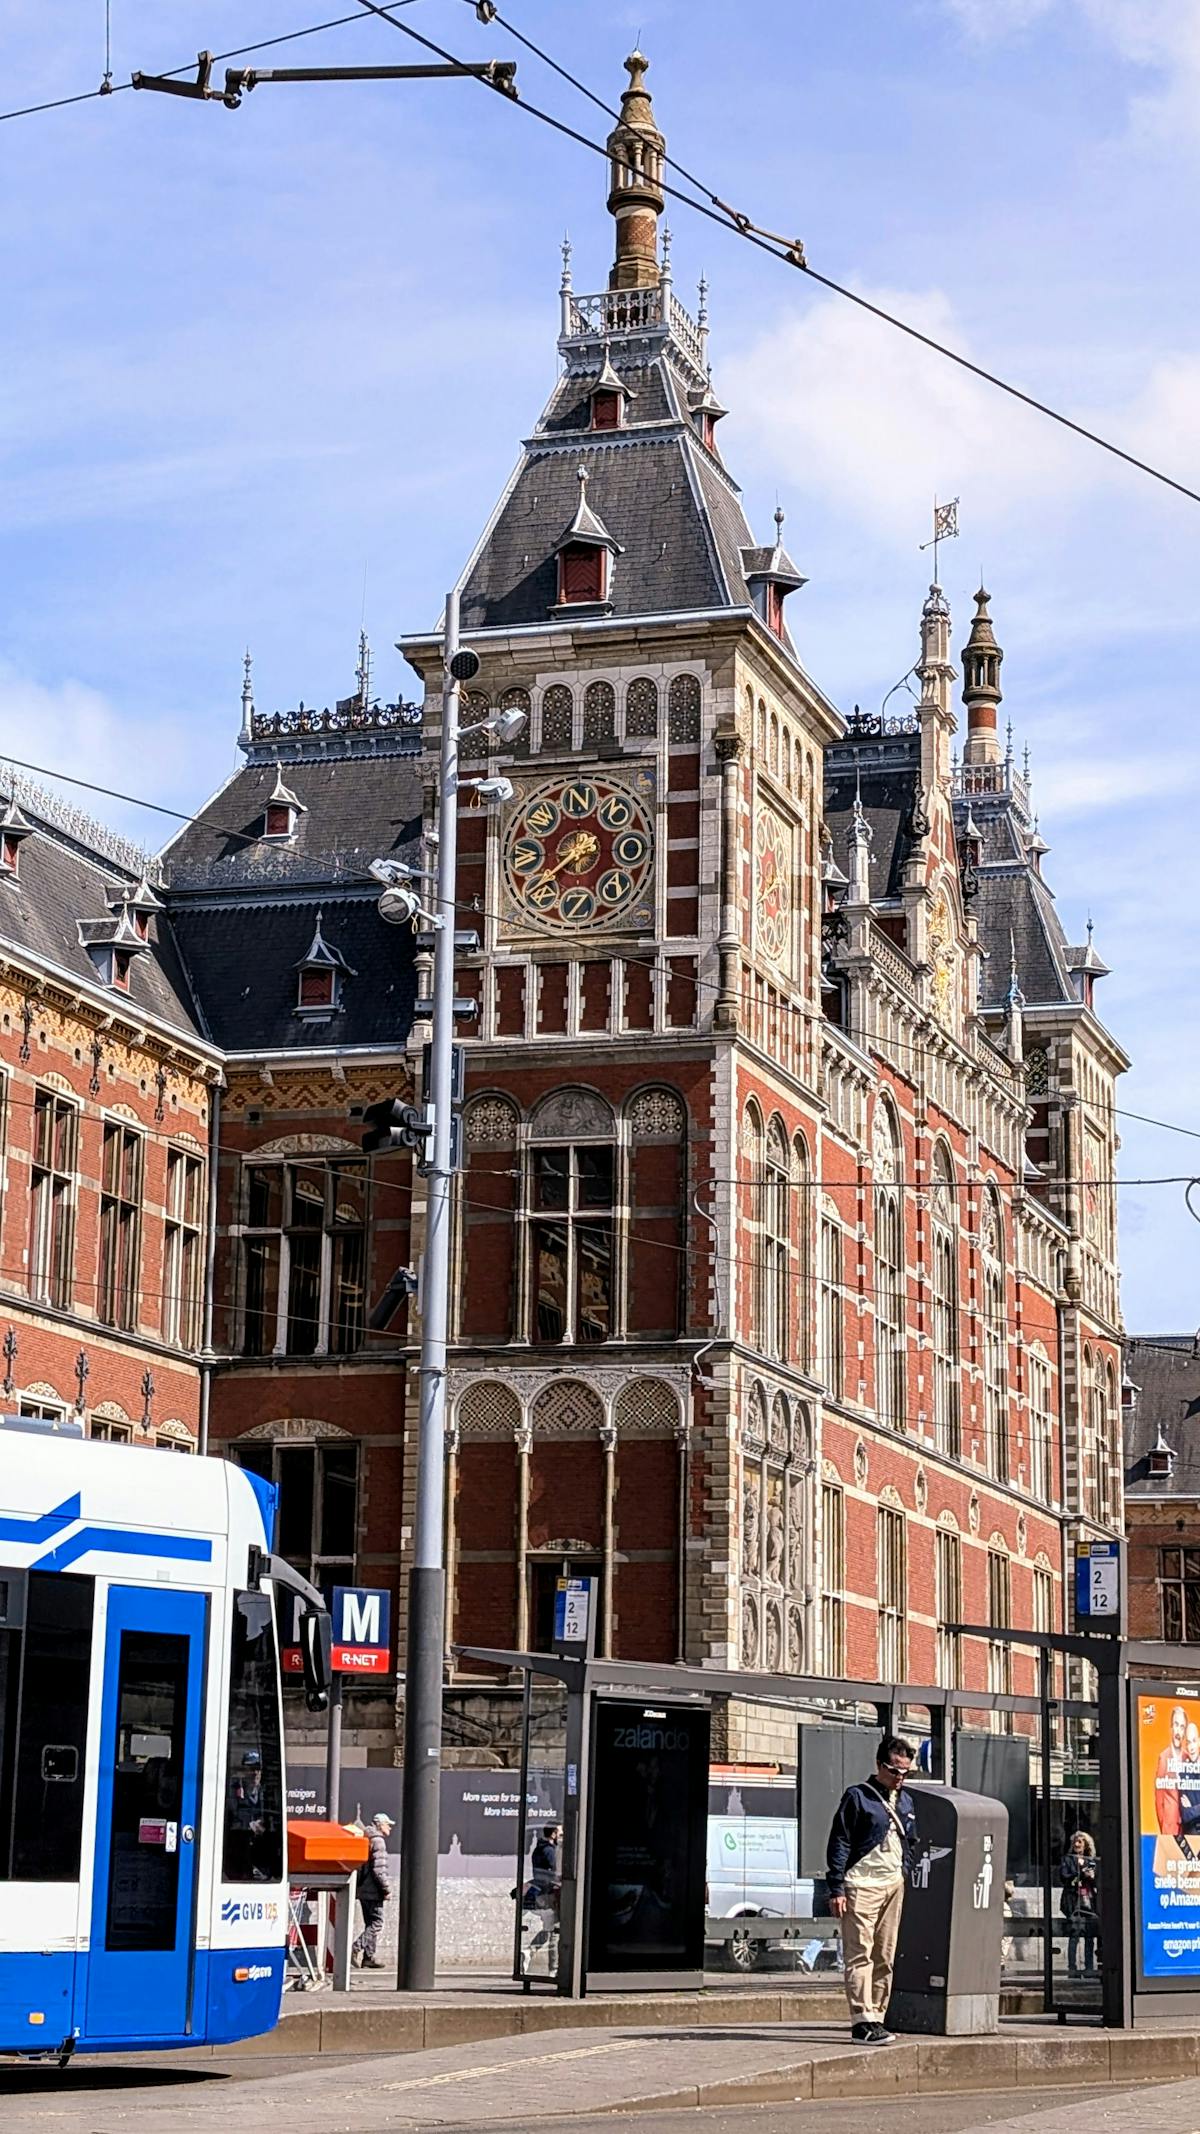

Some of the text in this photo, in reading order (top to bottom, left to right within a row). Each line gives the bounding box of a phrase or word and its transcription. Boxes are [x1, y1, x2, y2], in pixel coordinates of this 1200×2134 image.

[568, 788, 591, 812] N
[514, 844, 537, 870] W
[619, 837, 643, 862] O
[566, 893, 589, 919] Z
[1094, 1570, 1102, 1584] 2
[568, 1601, 575, 1614] 2
[1092, 1593, 1108, 1608] 12
[342, 1593, 380, 1644] M
[566, 1621, 578, 1634] 12
[341, 1652, 378, 1667] R-NET
[613, 1724, 690, 1751] zalando
[462, 1792, 480, 1802] More
[481, 1793, 499, 1803] space
[483, 1807, 500, 1816] More
[242, 1902, 263, 1920] GVB
[1163, 1939, 1192, 1951] amazon
